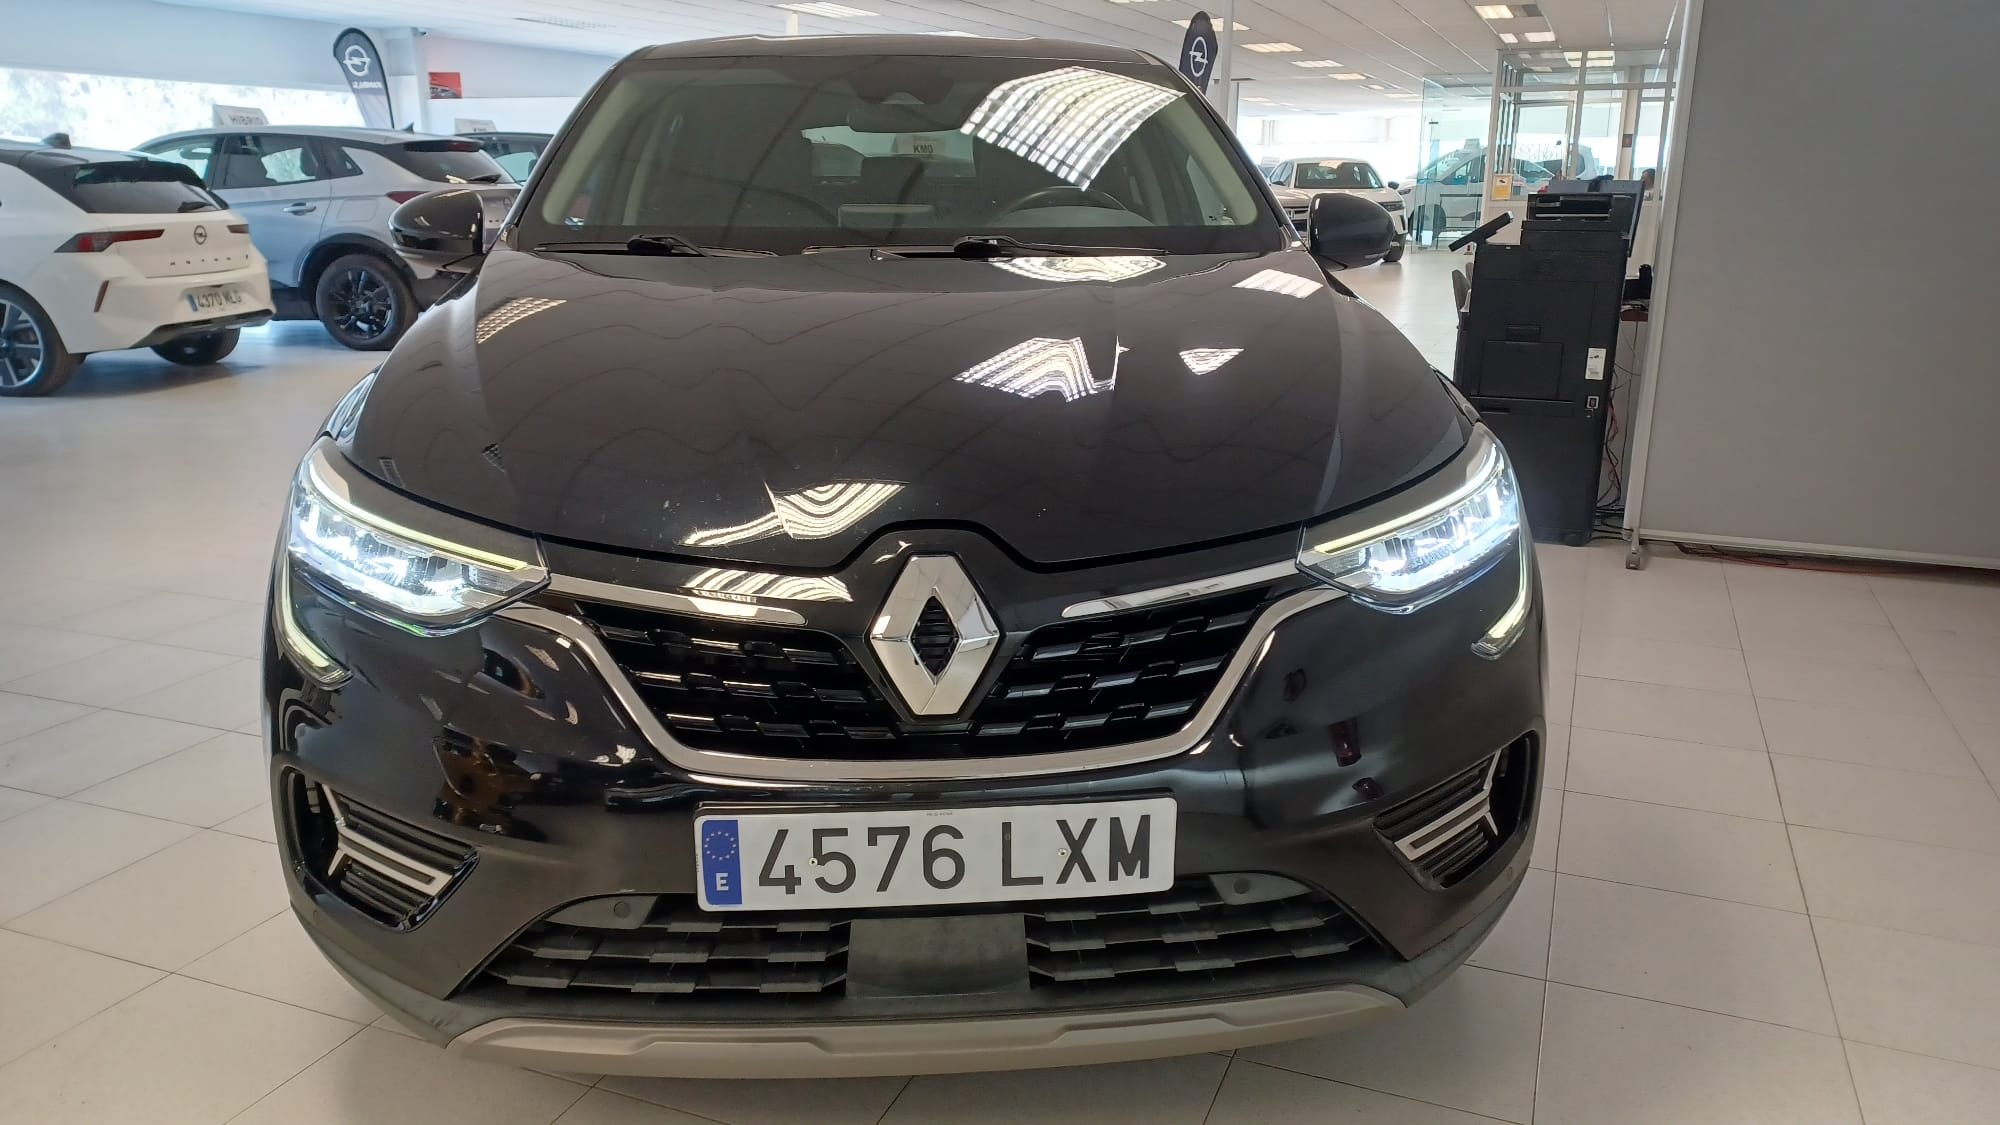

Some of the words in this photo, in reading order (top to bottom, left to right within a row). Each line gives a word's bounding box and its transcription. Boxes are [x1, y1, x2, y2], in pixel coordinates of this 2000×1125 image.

[758, 824, 966, 895] 4576
[1001, 814, 1151, 887] LXM
[715, 872, 729, 891] E
